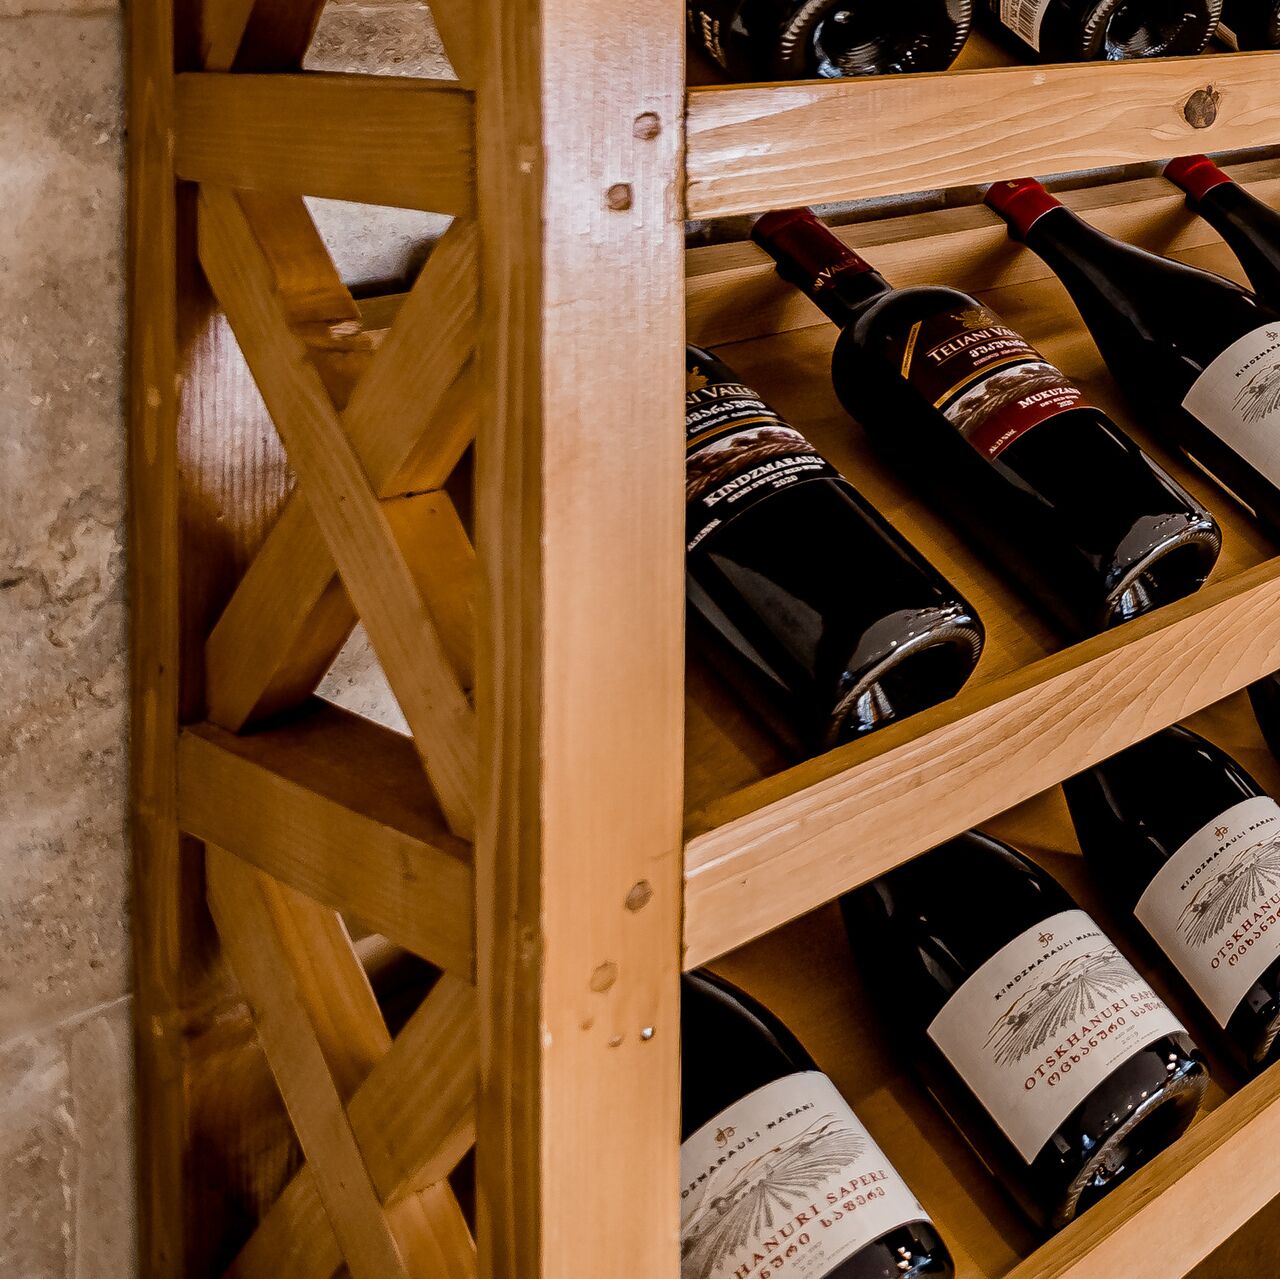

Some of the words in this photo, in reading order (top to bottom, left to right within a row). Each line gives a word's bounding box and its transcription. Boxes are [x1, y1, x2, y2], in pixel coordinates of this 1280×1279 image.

[927, 329, 993, 362] TELIANI
[702, 455, 826, 508] KINDZMARAULI
[772, 474, 799, 488] 2020
[1179, 831, 1247, 891] KINDZMARAULI
[993, 939, 1074, 1001] KINDZMARAULI
[1024, 998, 1129, 1091] OTSKHANURI
[766, 1102, 815, 1129] MARANI
[825, 1170, 889, 1205] SAPERE
